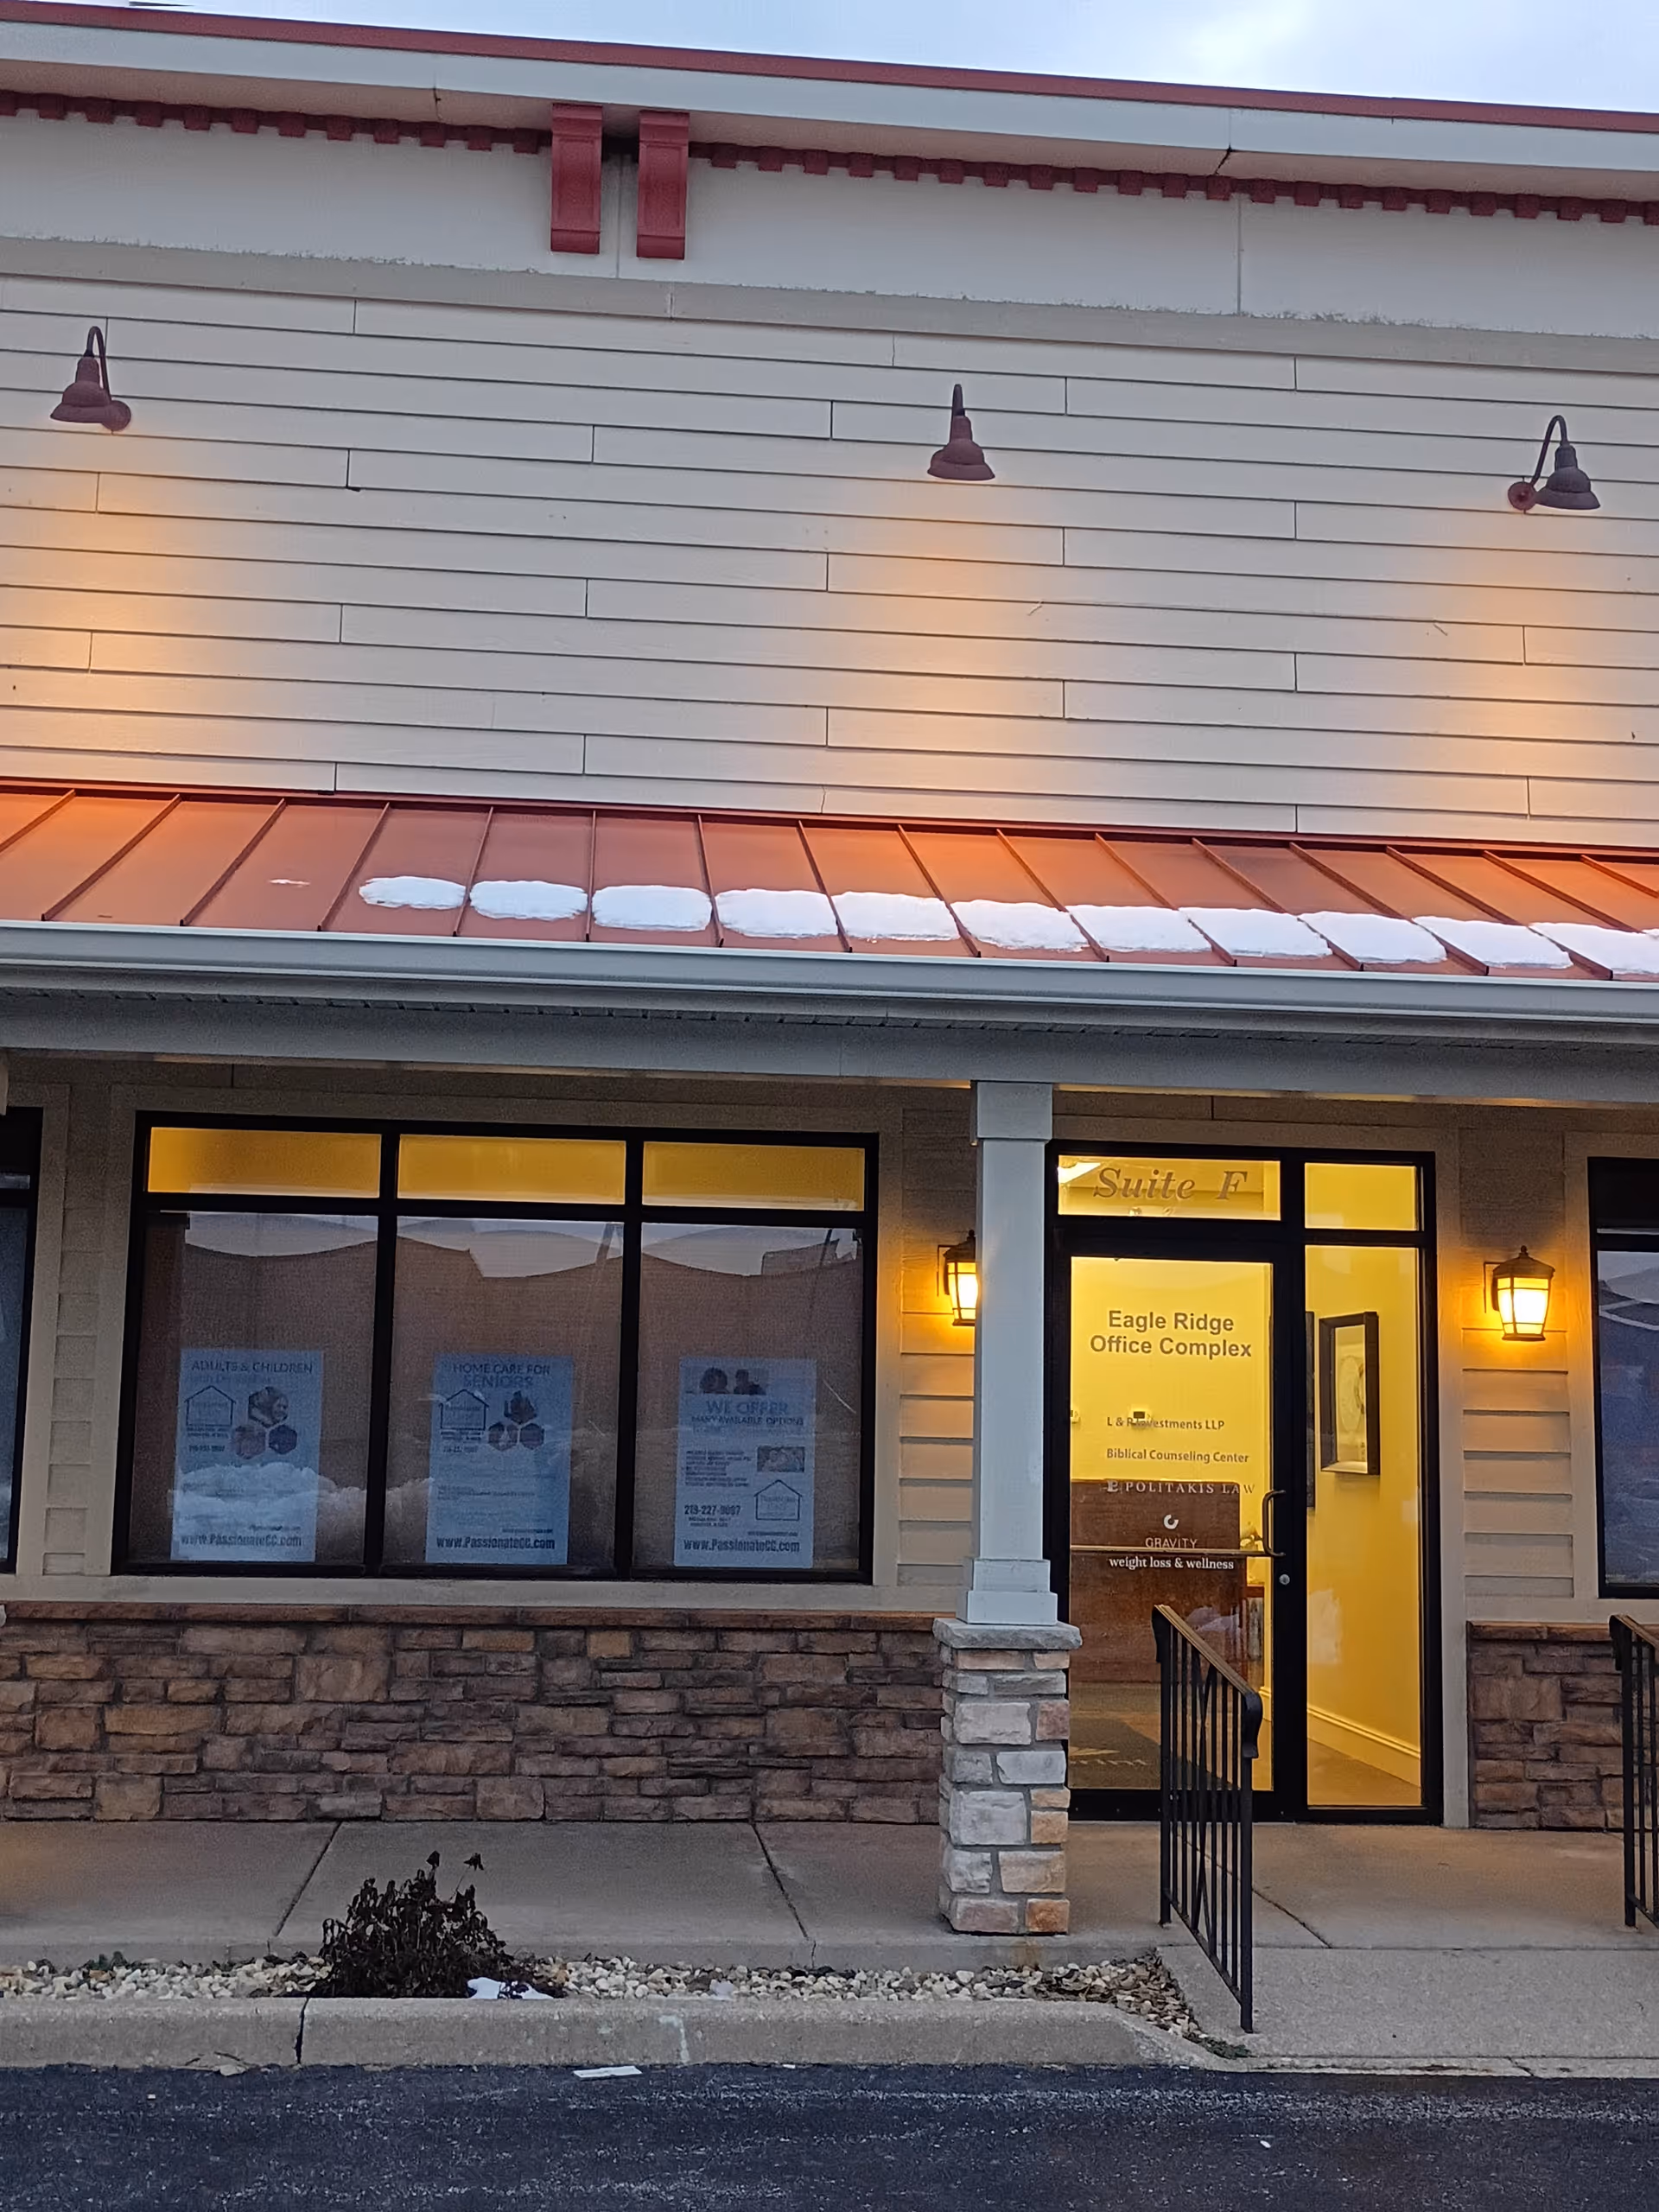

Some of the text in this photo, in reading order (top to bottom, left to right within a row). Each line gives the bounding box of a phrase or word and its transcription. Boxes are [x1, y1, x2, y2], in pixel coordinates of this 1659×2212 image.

[1093, 1167, 1248, 1200] Suite F
[1109, 1310, 1234, 1335] Eagle Ridge
[1090, 1335, 1251, 1360] Office Complex
[191, 1360, 238, 1372] ADULTS
[252, 1362, 313, 1374] CHILDREN
[453, 1363, 550, 1376] HOME CARE FOR
[463, 1374, 534, 1389] SENIORS
[706, 1400, 788, 1416] WE OFFER
[1107, 1417, 1113, 1426] L
[1116, 1417, 1124, 1427] &
[1205, 1420, 1224, 1430] LLP
[1107, 1448, 1249, 1464] Biblical Counseling Center
[1125, 1481, 1214, 1494] POLITAKIS
[1222, 1484, 1255, 1494] LAW
[1145, 1537, 1198, 1549] GRAVITY
[1109, 1556, 1234, 1571] weight loss & wellness
